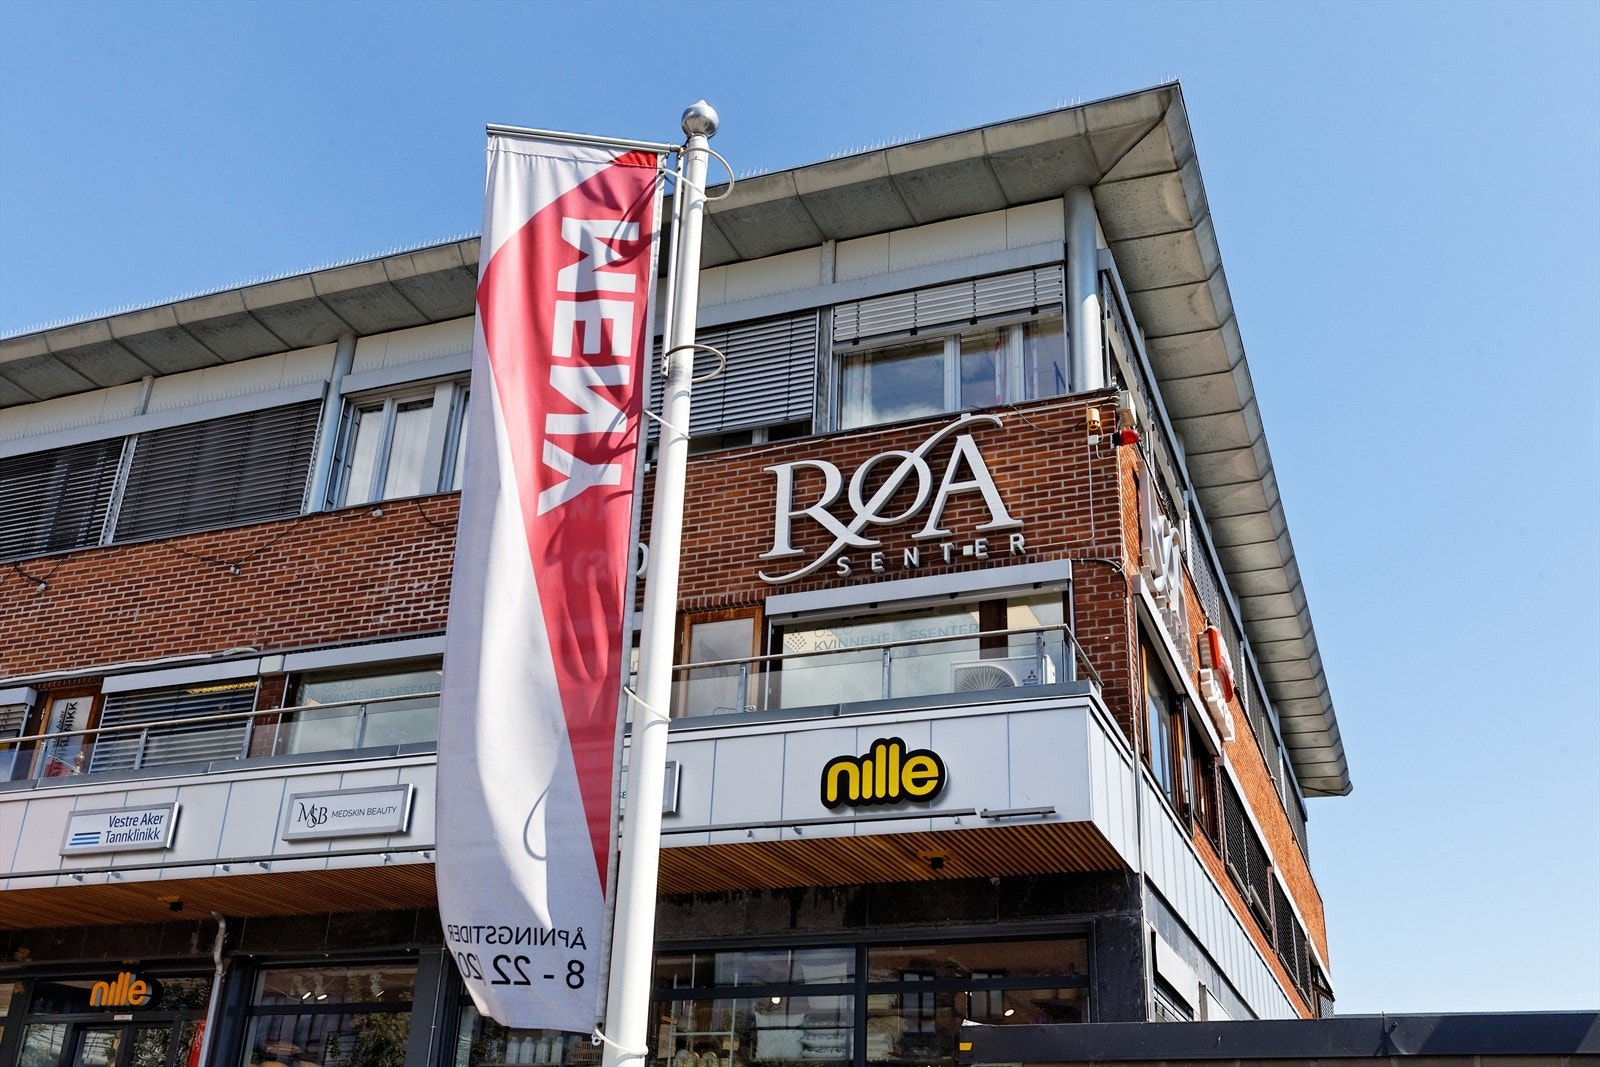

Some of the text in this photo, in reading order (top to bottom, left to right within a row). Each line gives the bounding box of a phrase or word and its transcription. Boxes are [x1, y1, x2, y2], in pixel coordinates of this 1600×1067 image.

[758, 413, 1025, 585] RØA
[837, 533, 1028, 577] SENTER
[814, 624, 853, 638] OSLO
[323, 681, 354, 692] OSLO
[825, 743, 940, 802] nille
[109, 812, 164, 828] Vestre Aker
[297, 802, 398, 828] MSB MEDSKIN BEAUTY
[106, 827, 160, 843] Tannklinikk
[89, 971, 149, 1007] nille
